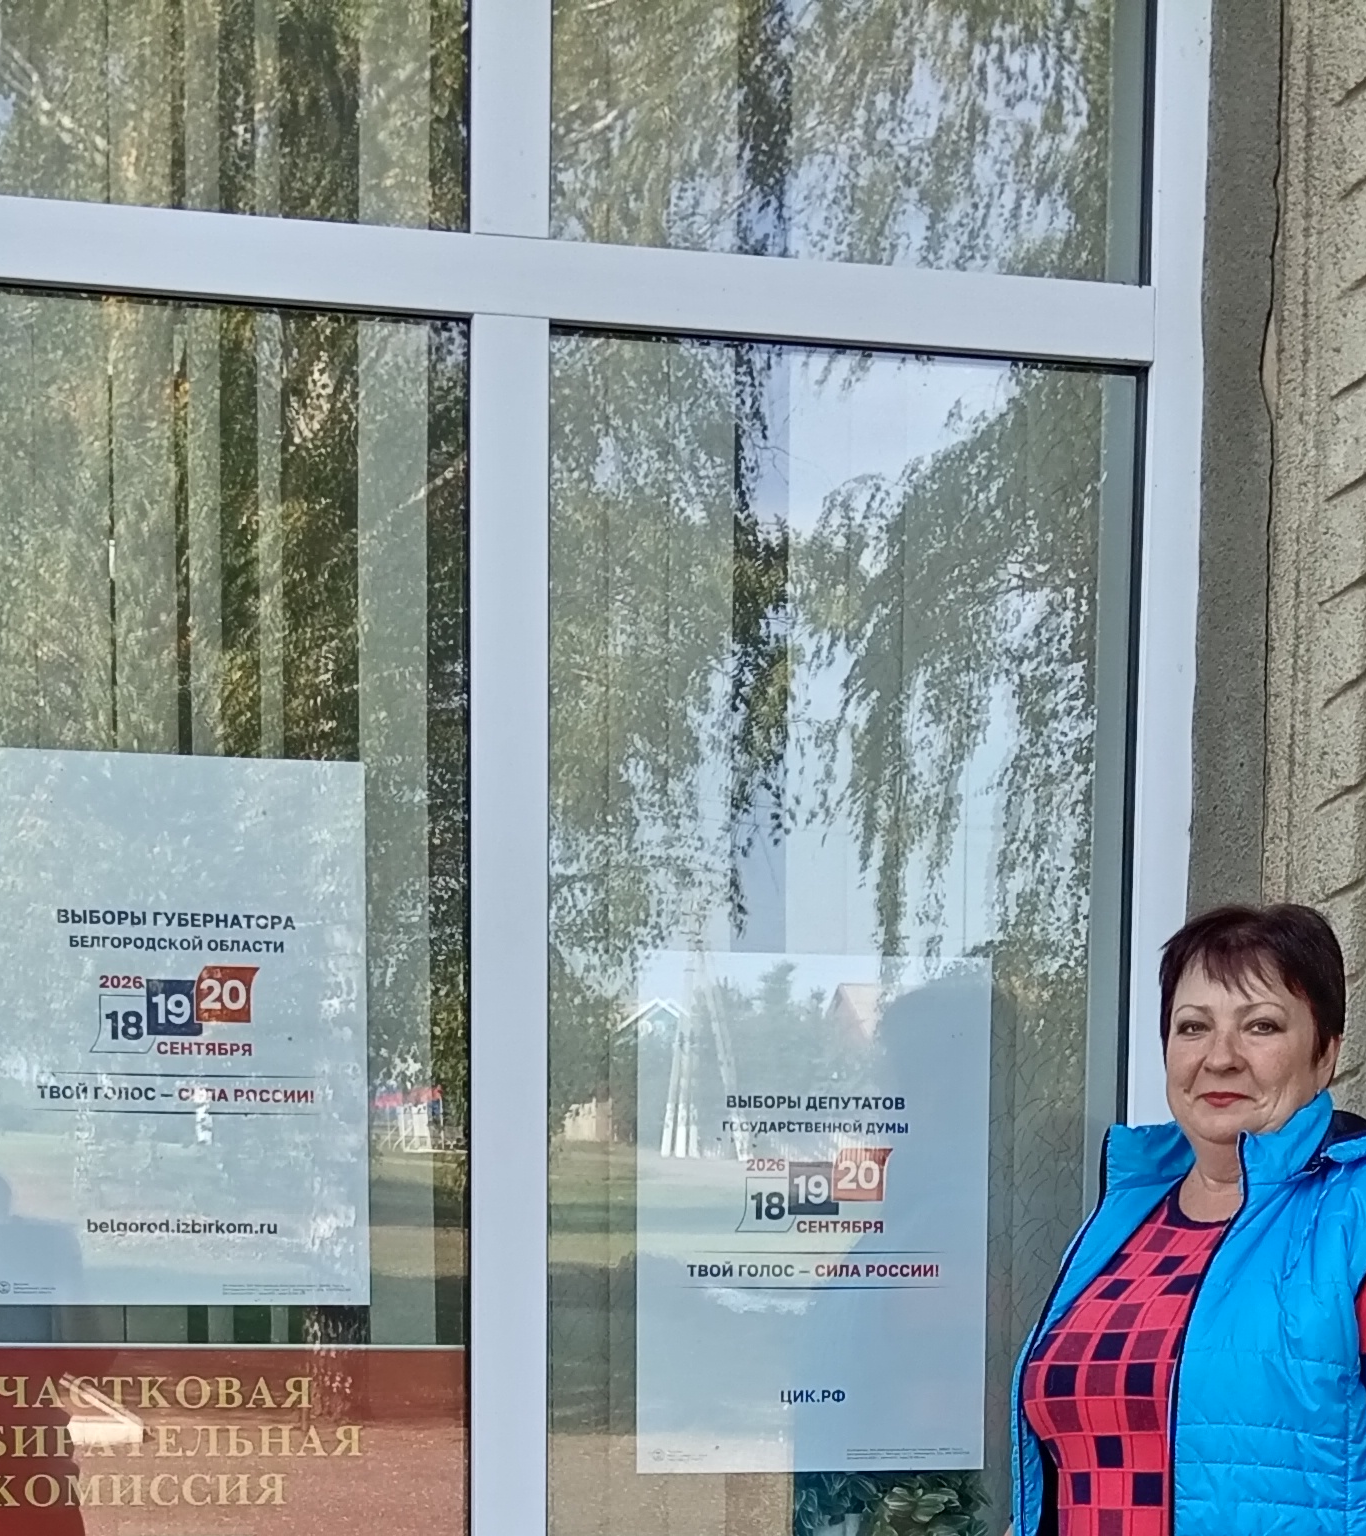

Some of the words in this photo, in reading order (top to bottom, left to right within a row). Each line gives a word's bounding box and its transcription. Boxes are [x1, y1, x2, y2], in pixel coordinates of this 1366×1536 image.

[56, 908, 147, 927] ВЫБОРЫ
[152, 911, 296, 931] ГУБЕРНАТОРА
[69, 935, 203, 952] БЕЛГОРОДСКОЙ
[207, 939, 285, 953] ОБЛАСТИ
[99, 975, 143, 989] 2026
[105, 1010, 144, 1040] 18
[151, 993, 192, 1025] 19
[199, 978, 247, 1010] 20
[156, 1041, 253, 1056] СЕНТЯБРЯ
[36, 1082, 88, 1099] ТВОЙ
[94, 1086, 156, 1101] ГОЛОС
[178, 1087, 229, 1102] СЛА
[233, 1088, 315, 1104] РОССИИ!
[726, 1095, 801, 1109] ВЫБОРЫ
[805, 1096, 906, 1111] ДЕПУТАТОВ
[722, 1119, 862, 1134] ГОСУДАРСТВЕННОЙ
[866, 1122, 909, 1135] ДУМЫ
[746, 1158, 785, 1172] 2026
[750, 1191, 785, 1220] 18
[793, 1174, 829, 1205] 19
[837, 1160, 880, 1190] 20
[86, 1218, 278, 1237] belgorod.izbirkom.ru
[796, 1220, 884, 1234] СЕНТЯБРЯ
[687, 1261, 734, 1277] ТВОЙ
[738, 1264, 795, 1278] ГОЛОС
[814, 1264, 861, 1278] СИЛА
[865, 1264, 940, 1278] РОССИИ!
[780, 1389, 846, 1405] ЦИК.РФ
